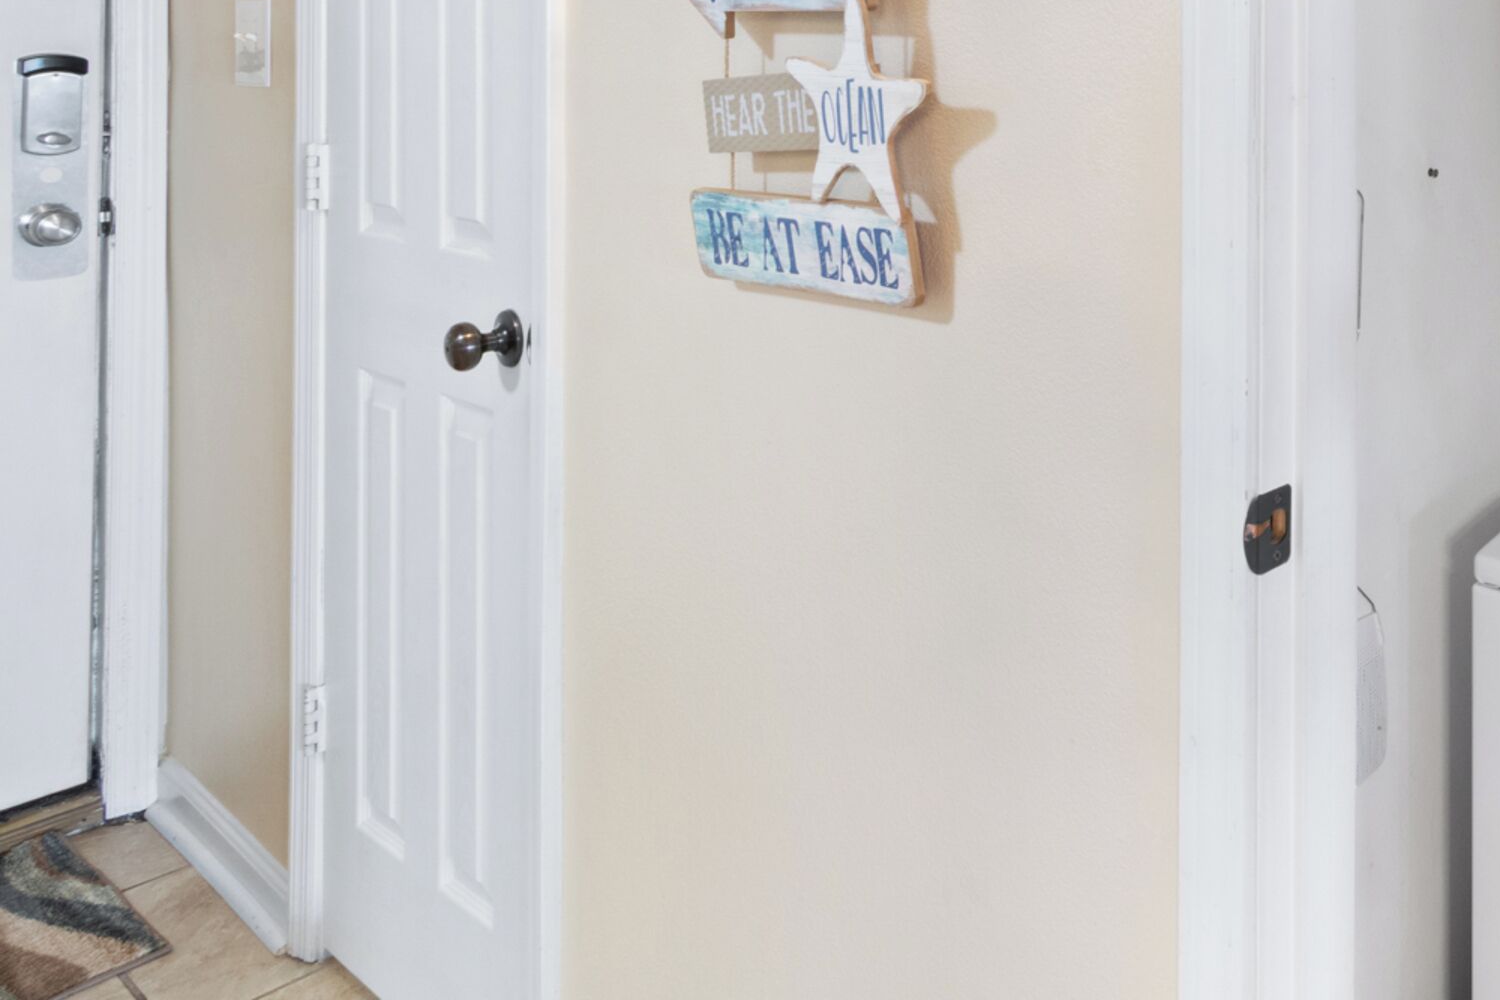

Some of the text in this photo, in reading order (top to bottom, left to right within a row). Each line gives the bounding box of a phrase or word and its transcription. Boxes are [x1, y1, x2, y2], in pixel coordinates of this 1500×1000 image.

[711, 87, 816, 138] HEAR THE
[821, 78, 887, 155] OCEAN
[705, 207, 900, 290] BE AT EASE
